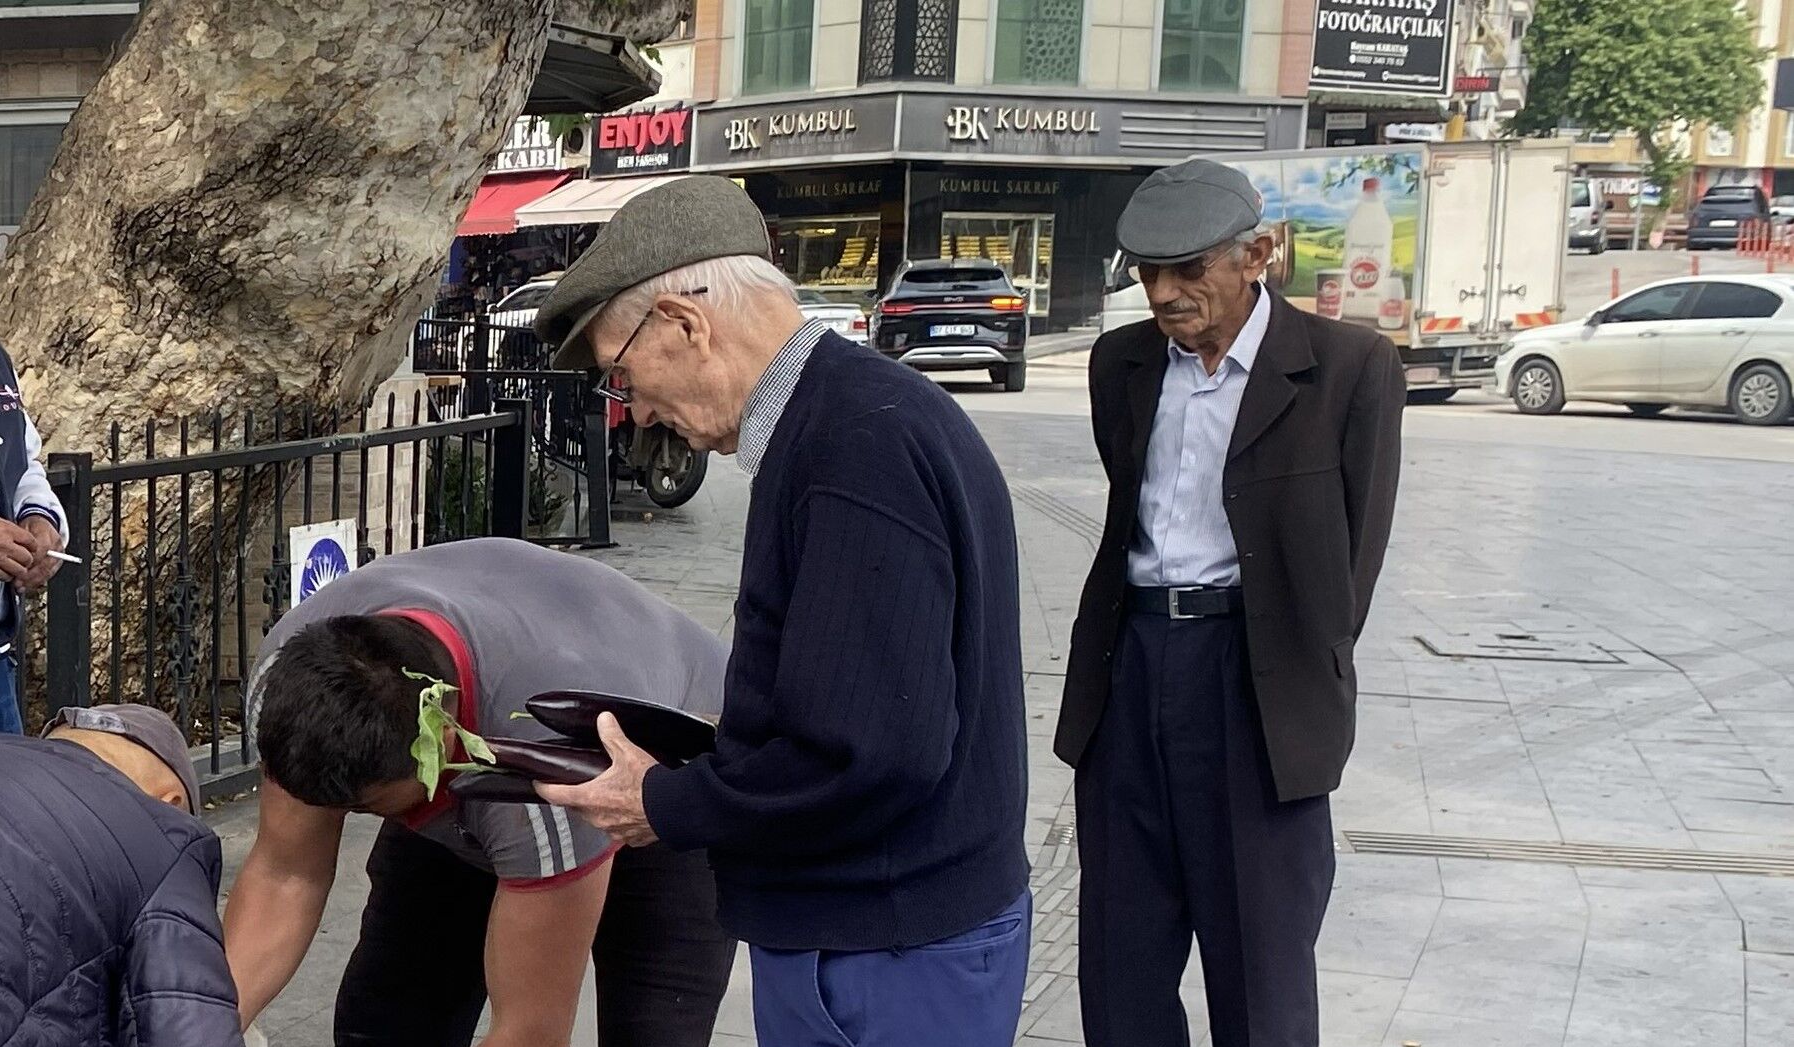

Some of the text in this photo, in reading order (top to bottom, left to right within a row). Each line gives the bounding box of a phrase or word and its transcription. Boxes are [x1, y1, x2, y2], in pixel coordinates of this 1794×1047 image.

[1318, 9, 1445, 40] FOTOĞRAFÇILIK
[599, 111, 688, 154] ENJOY
[768, 108, 856, 136] KUMBUL
[995, 107, 1102, 133] KUMBUL
[492, 148, 555, 170] KABI
[777, 183, 828, 199] KUMBUL
[940, 178, 1000, 194] KUMBUL
